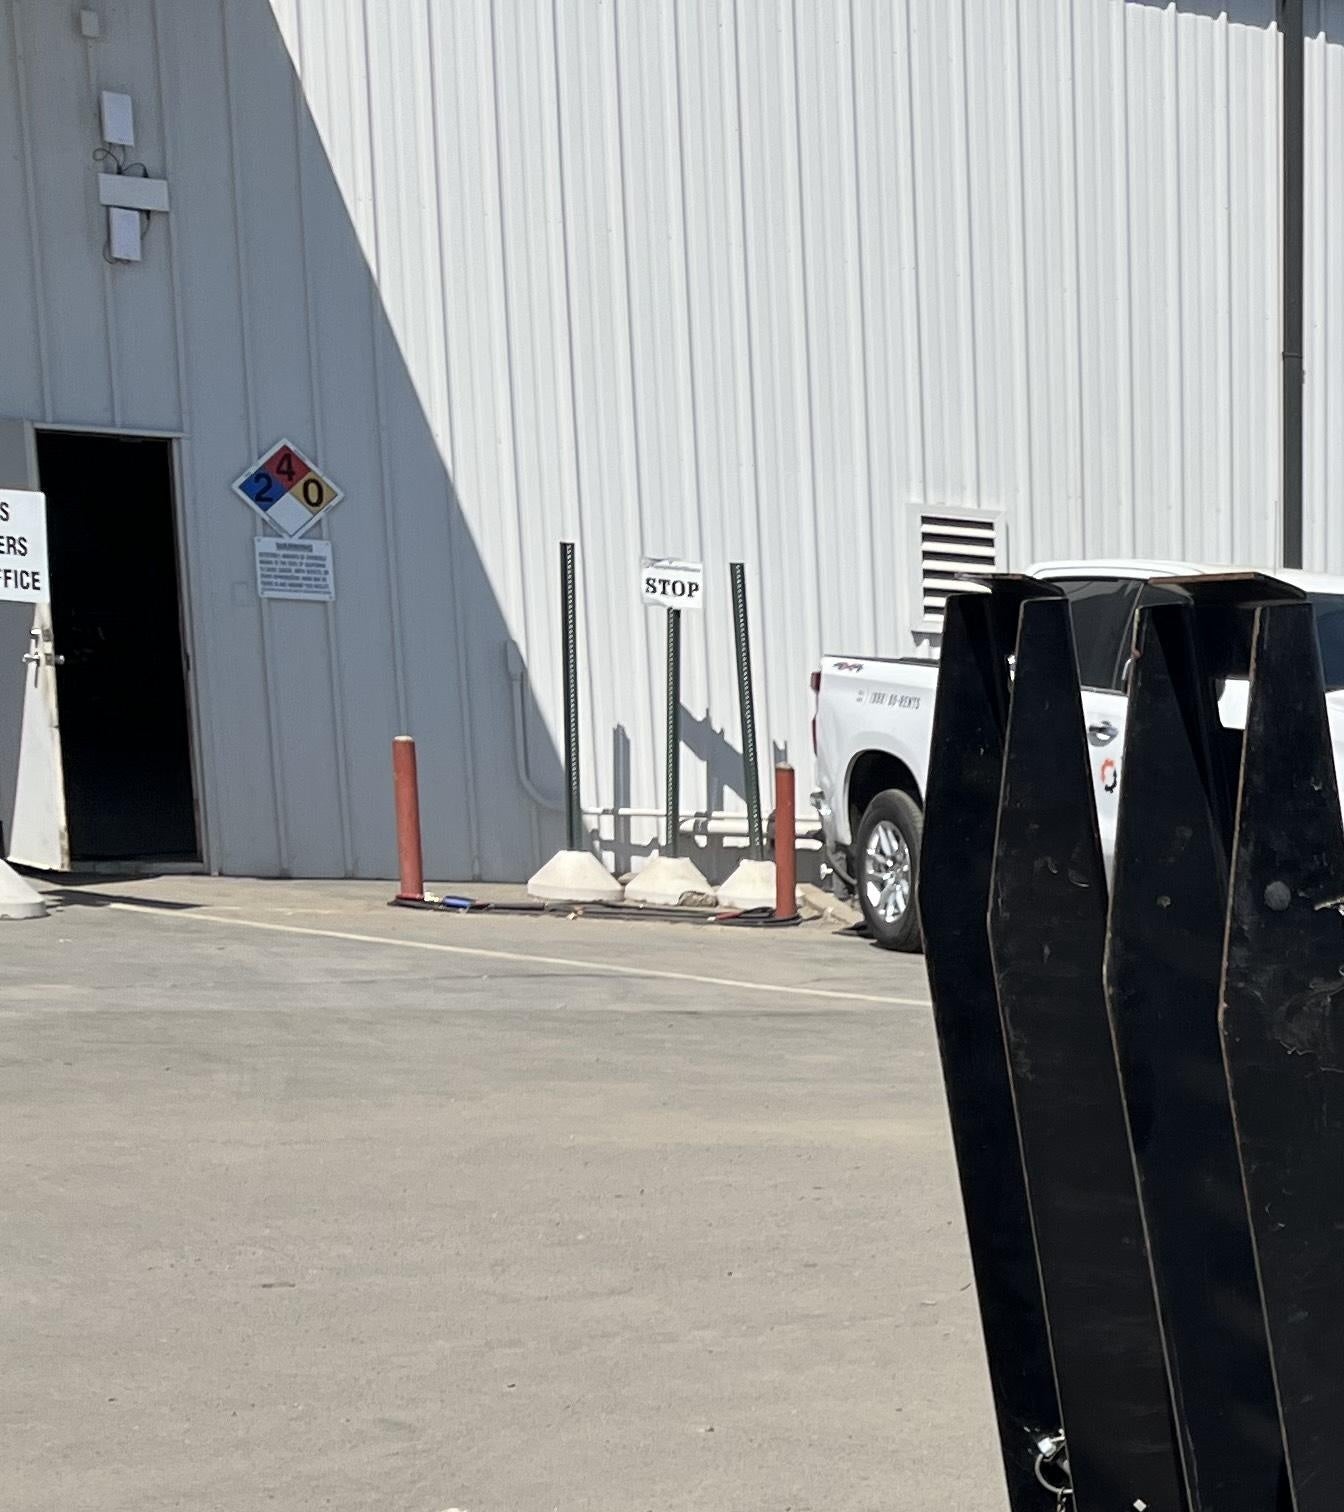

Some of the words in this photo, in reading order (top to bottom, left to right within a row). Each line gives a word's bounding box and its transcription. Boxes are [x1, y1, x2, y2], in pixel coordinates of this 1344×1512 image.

[276, 453, 296, 481] 4
[254, 472, 273, 502] 2
[302, 478, 323, 507] 0
[0, 569, 41, 590] FICE
[645, 577, 700, 598] STOP
